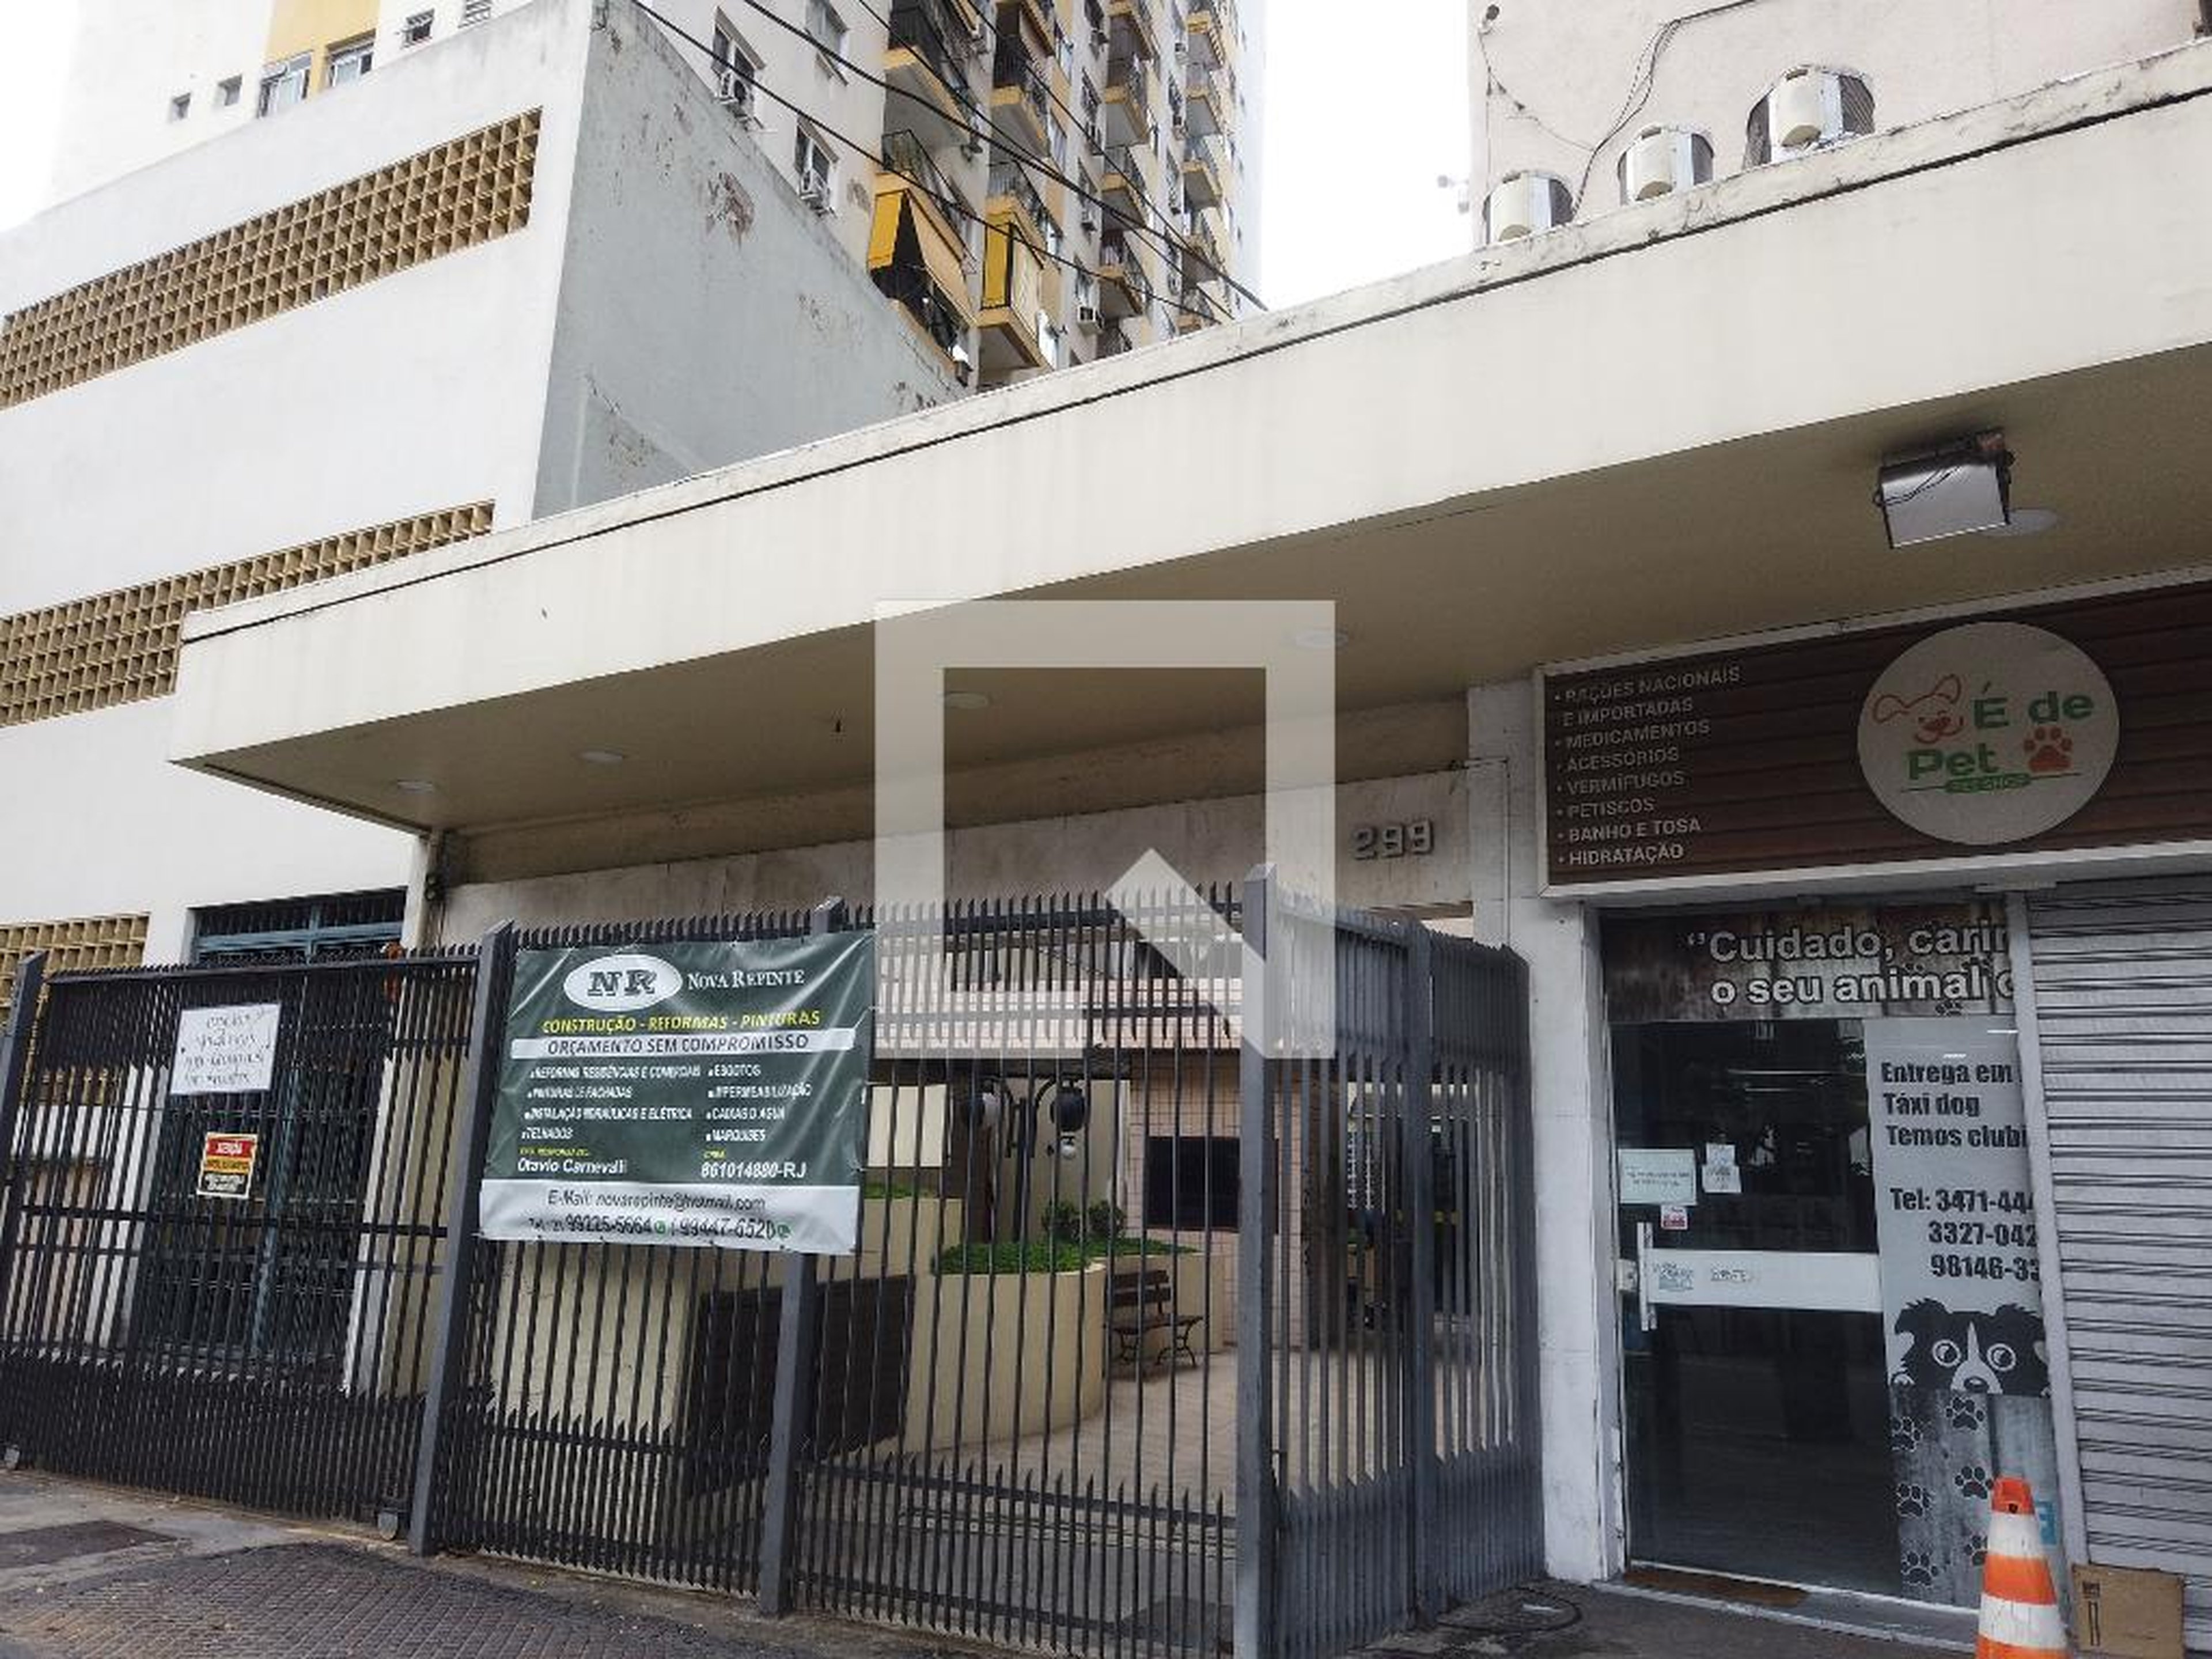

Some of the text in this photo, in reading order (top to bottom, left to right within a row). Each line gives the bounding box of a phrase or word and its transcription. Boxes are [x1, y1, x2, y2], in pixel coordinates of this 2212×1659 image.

[1639, 666, 1740, 693] NACIONAIS
[1563, 697, 1694, 726] E IMPORTADAS
[1974, 682, 2094, 729] É de
[1567, 719, 1711, 749] MEDICAMENTOS
[1907, 744, 1999, 779] Pet
[1569, 797, 1656, 818] PETISCOS
[1354, 821, 1434, 859] 299
[1570, 819, 1702, 842] BANHO E TOSA
[1570, 843, 1684, 865] HIDRATAÇÃO
[588, 969, 657, 997] NR
[1711, 980, 1735, 1003] o
[1747, 979, 1821, 1003] seu
[1835, 965, 1982, 1002] animal
[543, 1015, 635, 1035] CONSTRUÇÃO
[648, 1016, 727, 1031] REFORMAS
[740, 1011, 820, 1028] PINTURAS
[547, 1035, 809, 1055] ORÇAMENTO SEM COMPROMISSO
[1881, 1062, 1970, 1085] Entrega
[1976, 1065, 2012, 1083] em
[1883, 1093, 1979, 1117] Táxi dog
[1885, 1126, 1962, 1146] Temos
[1890, 1188, 1930, 1210] Tel:
